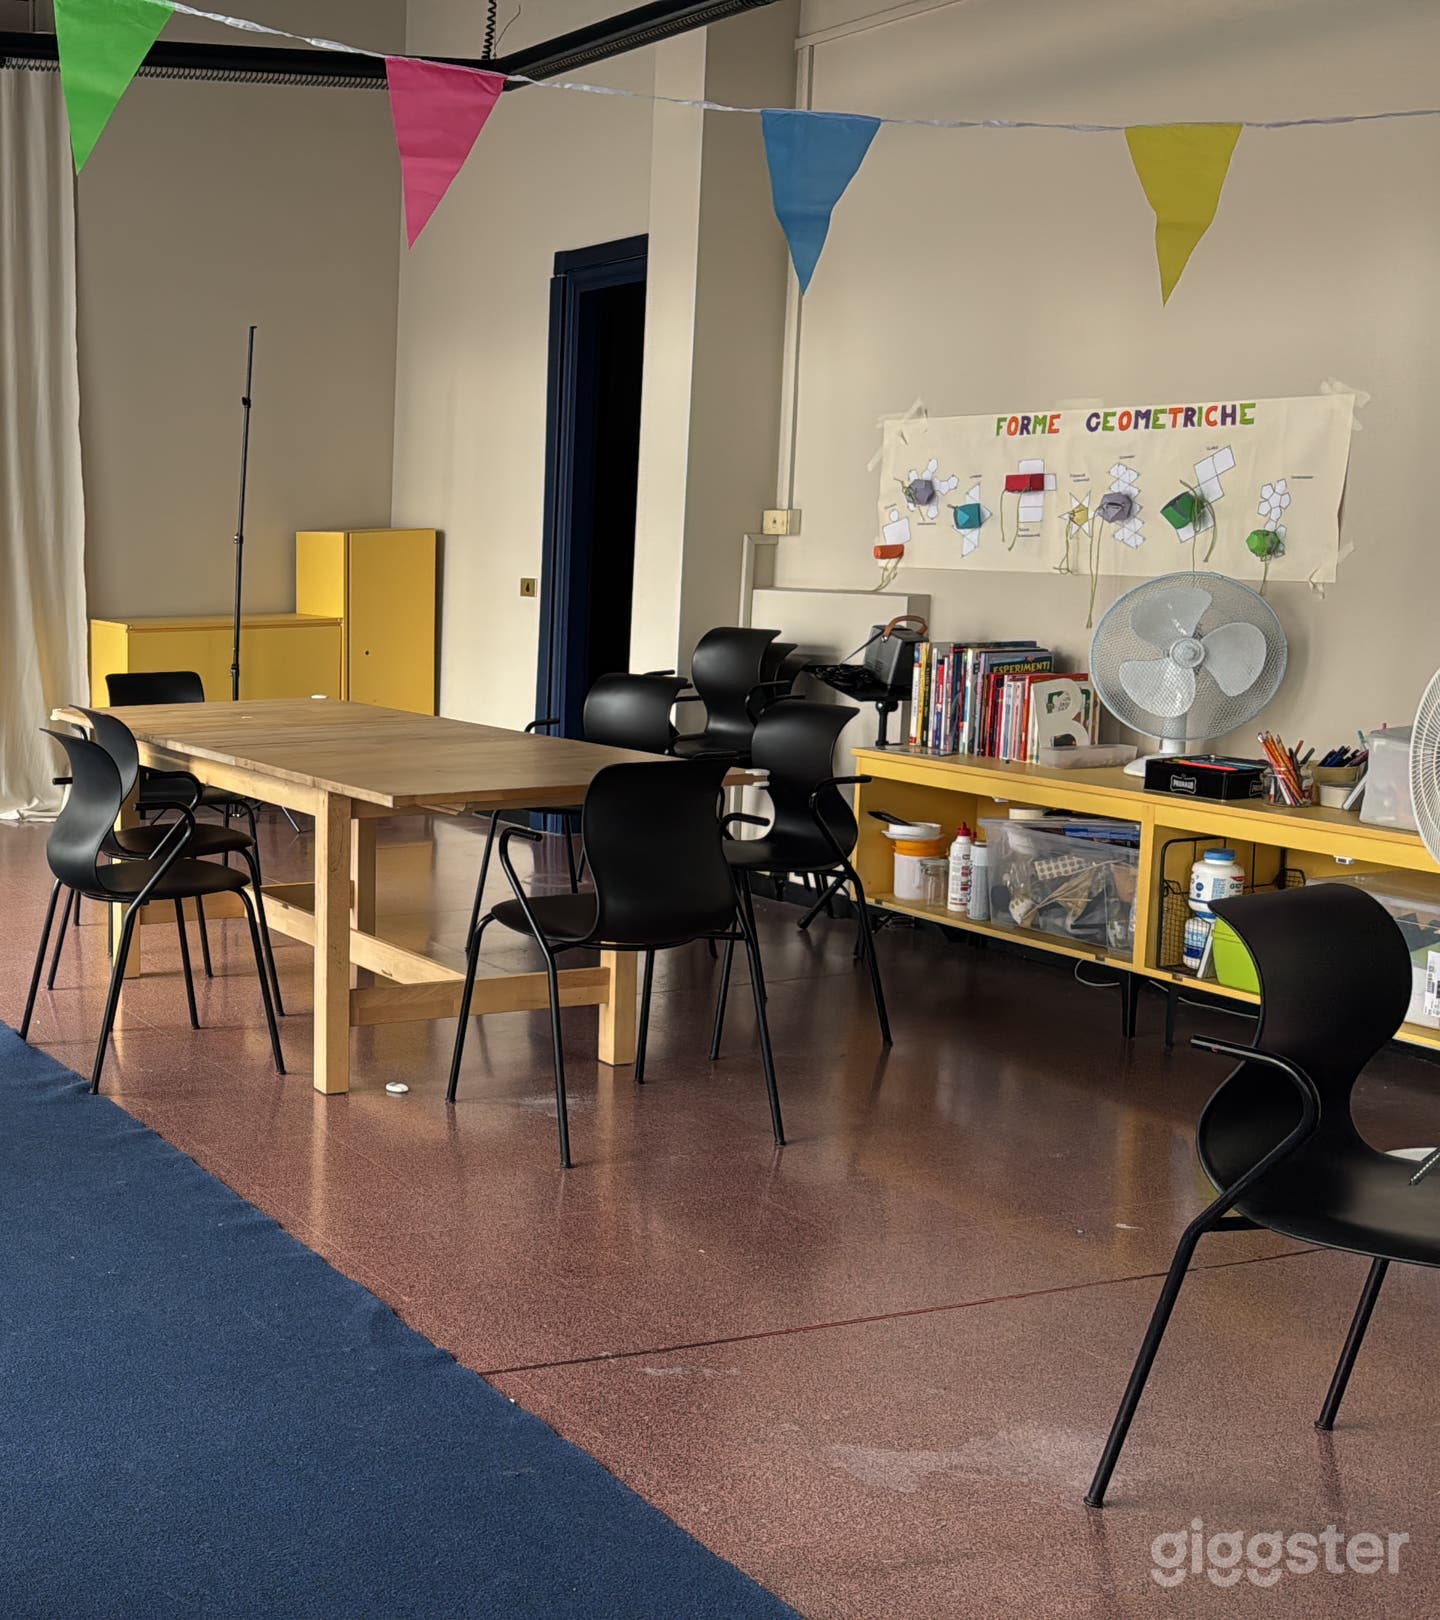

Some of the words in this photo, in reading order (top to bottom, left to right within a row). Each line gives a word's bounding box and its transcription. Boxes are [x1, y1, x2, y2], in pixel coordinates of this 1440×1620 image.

[995, 413, 1062, 437] FORME
[1085, 402, 1257, 433] GEOMETRICHE
[993, 661, 1050, 674] ESPERIMENTI
